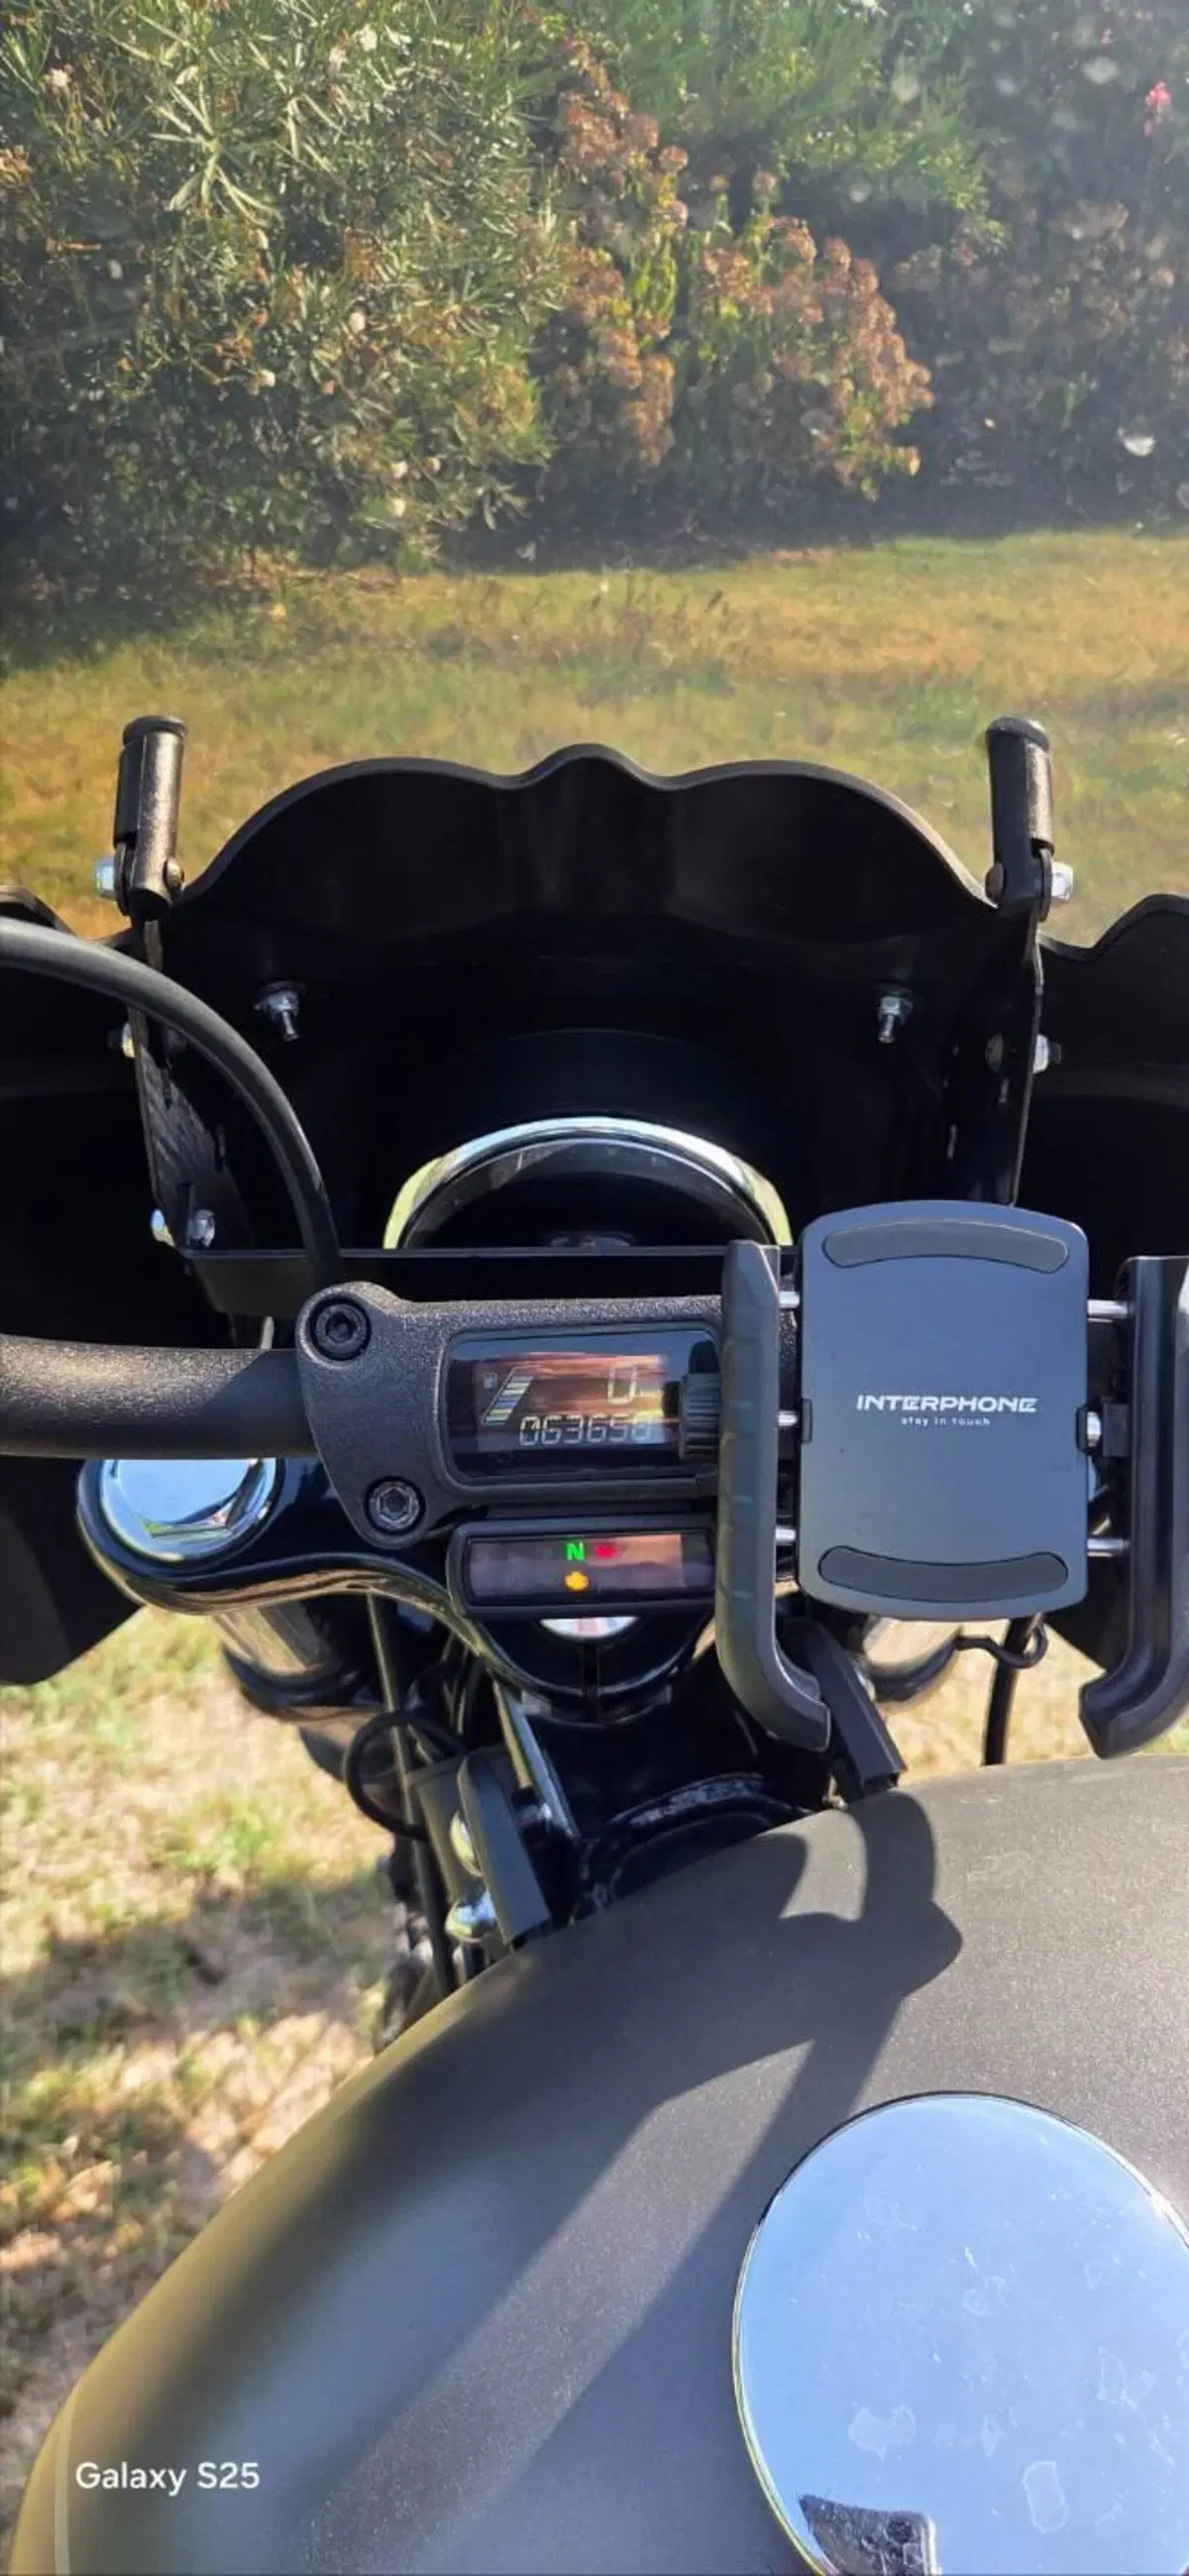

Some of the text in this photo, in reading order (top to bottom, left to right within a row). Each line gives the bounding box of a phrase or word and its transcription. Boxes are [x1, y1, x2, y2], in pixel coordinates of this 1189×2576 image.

[856, 1395, 1038, 1413] INTERPHONE
[901, 1415, 991, 1427] stay in touch
[565, 1541, 586, 1561] N
